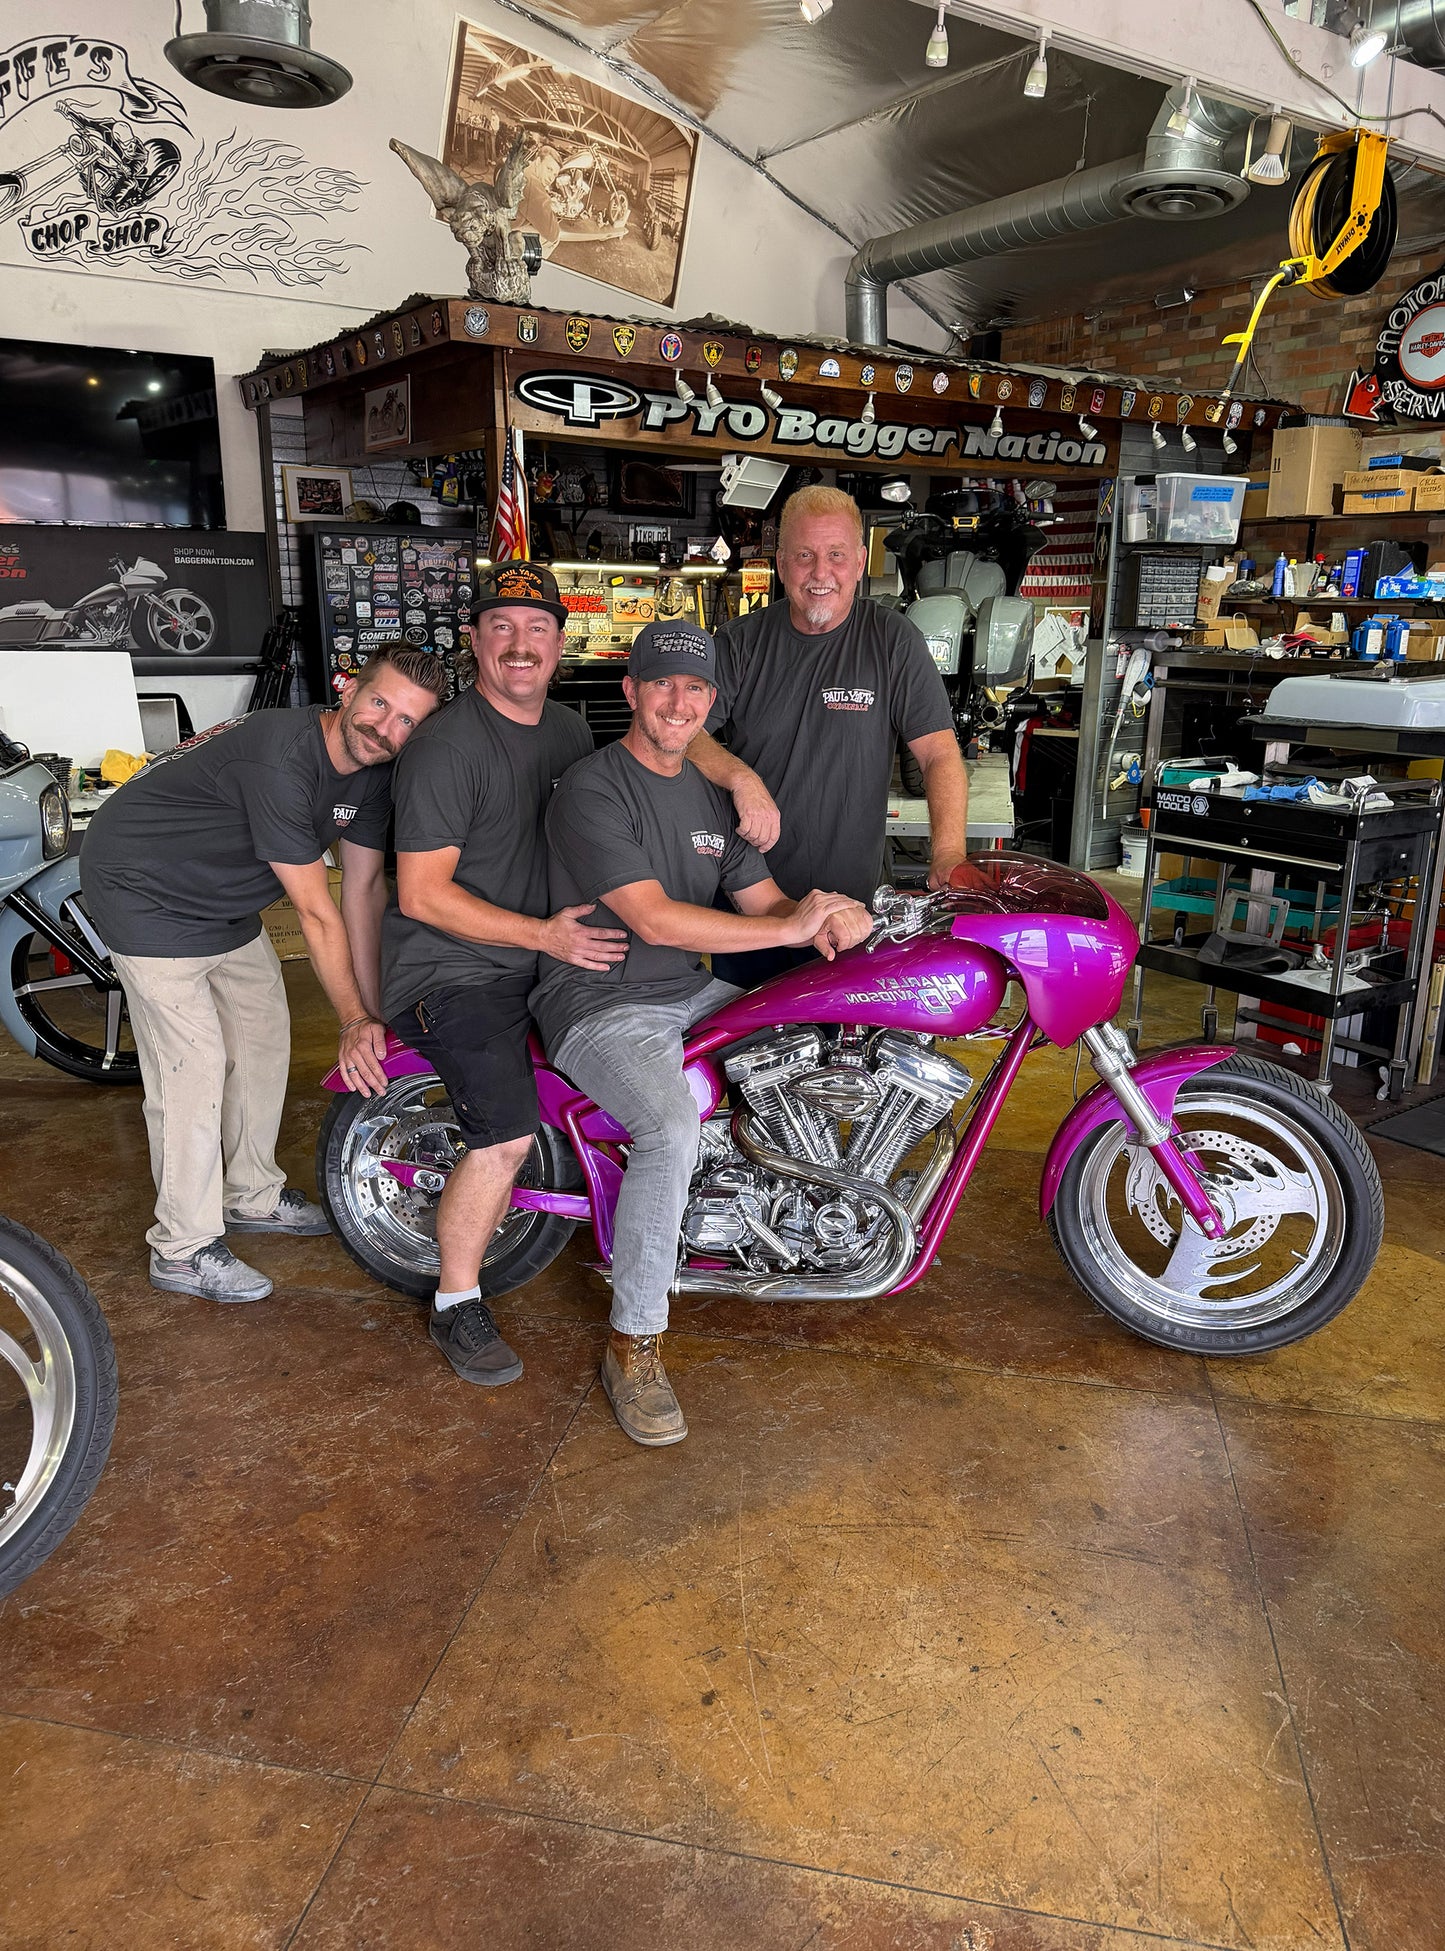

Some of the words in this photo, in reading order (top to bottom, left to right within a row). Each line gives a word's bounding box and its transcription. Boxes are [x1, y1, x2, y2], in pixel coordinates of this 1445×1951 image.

[31, 214, 90, 252] CHOP
[102, 218, 160, 252] SHOP
[643, 392, 768, 438] PYO
[775, 406, 958, 456] Bagger
[962, 424, 1108, 466] Nation
[173, 547, 194, 556] SHOP
[195, 548, 215, 557] NOW!
[174, 556, 255, 566] BAGGERNATION.COM
[497, 568, 518, 583] PAUL
[572, 586, 605, 596] Yaffe's
[560, 595, 604, 605] agger
[562, 602, 608, 613] ation
[360, 629, 401, 641] COMETIC
[652, 632, 676, 640] Paul
[652, 638, 706, 650] Bagger
[659, 644, 708, 661] Nation
[822, 690, 849, 704] PAUL
[1156, 792, 1191, 804] MATCO
[1156, 800, 1190, 813] TOOLS
